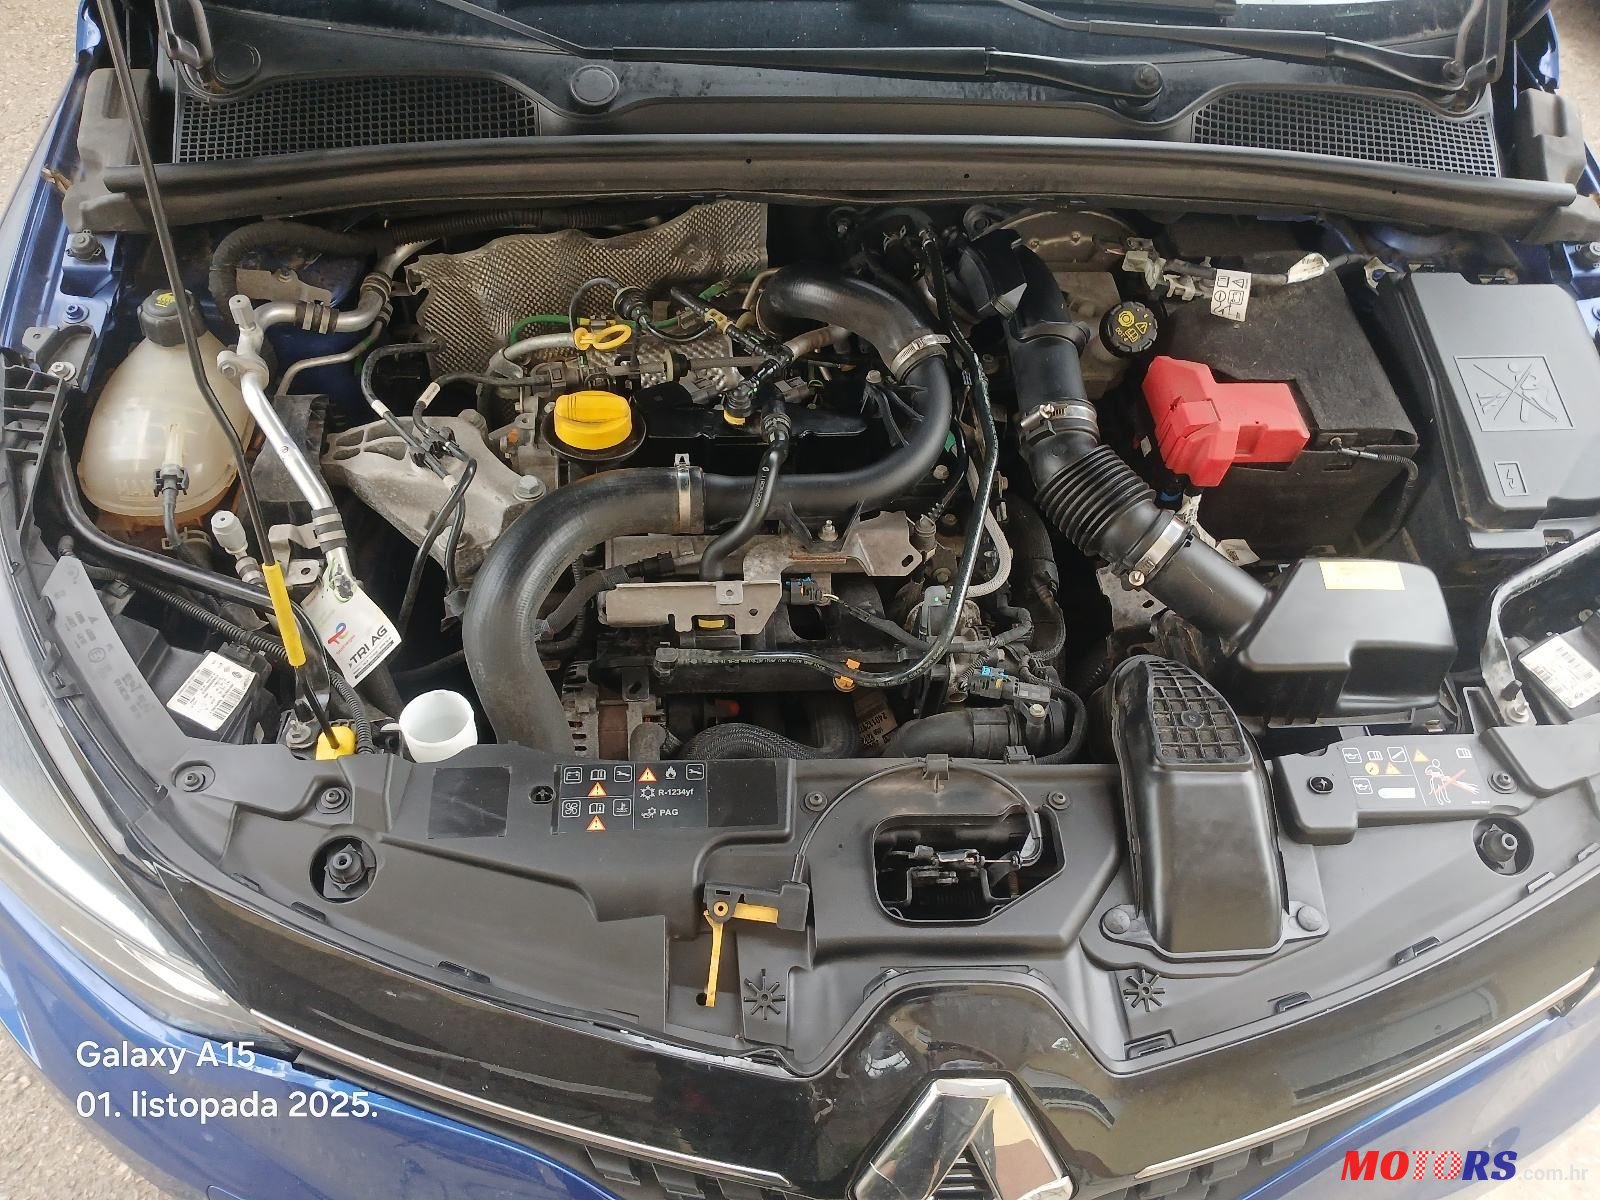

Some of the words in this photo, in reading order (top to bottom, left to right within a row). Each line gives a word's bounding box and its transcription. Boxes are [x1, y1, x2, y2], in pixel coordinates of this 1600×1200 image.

[372, 625, 388, 647] AG
[658, 787, 694, 797] R-1234yf
[659, 808, 679, 817] PAG
